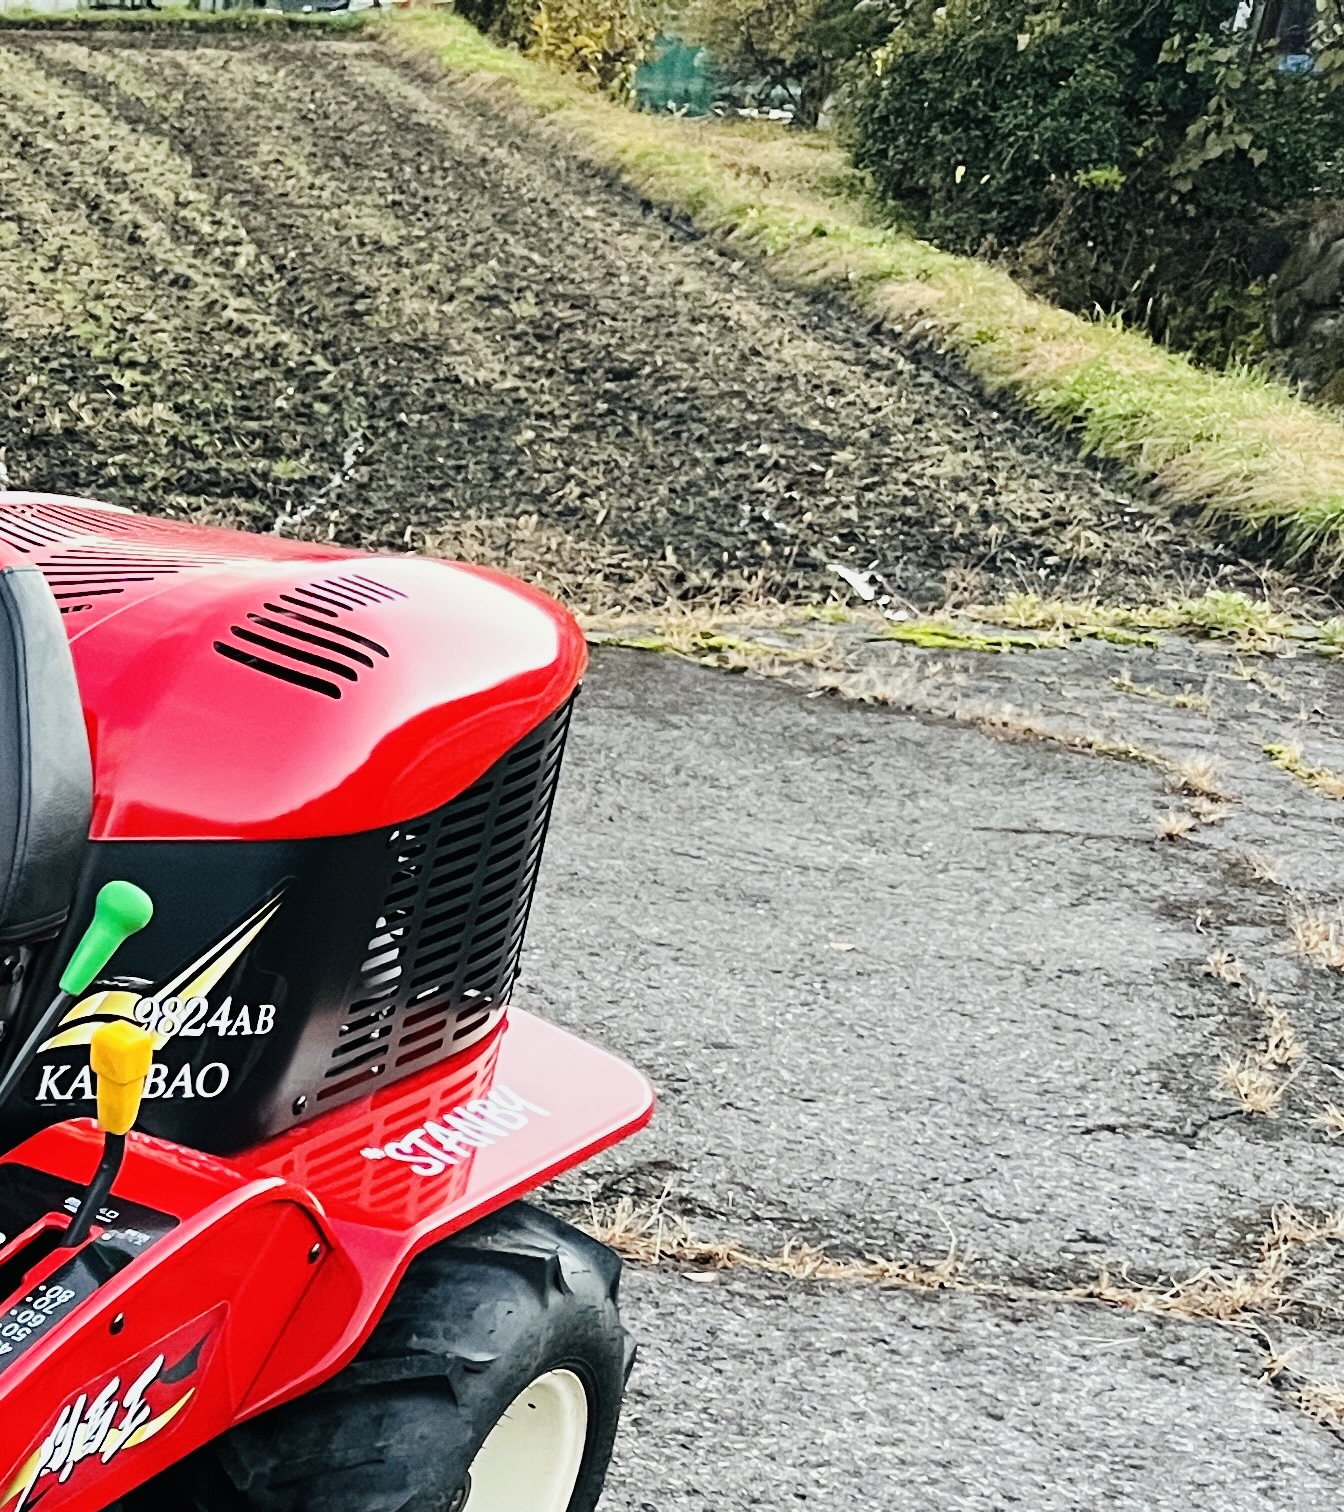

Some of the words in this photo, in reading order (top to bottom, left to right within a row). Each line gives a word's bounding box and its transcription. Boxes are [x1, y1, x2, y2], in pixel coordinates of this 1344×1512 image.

[134, 996, 277, 1038] 9824AB
[35, 1062, 230, 1101] KABAO
[46, 1285, 76, 1303] 80
[32, 1296, 60, 1314] 70
[17, 1308, 46, 1327] 60
[2, 1322, 31, 1341] 50
